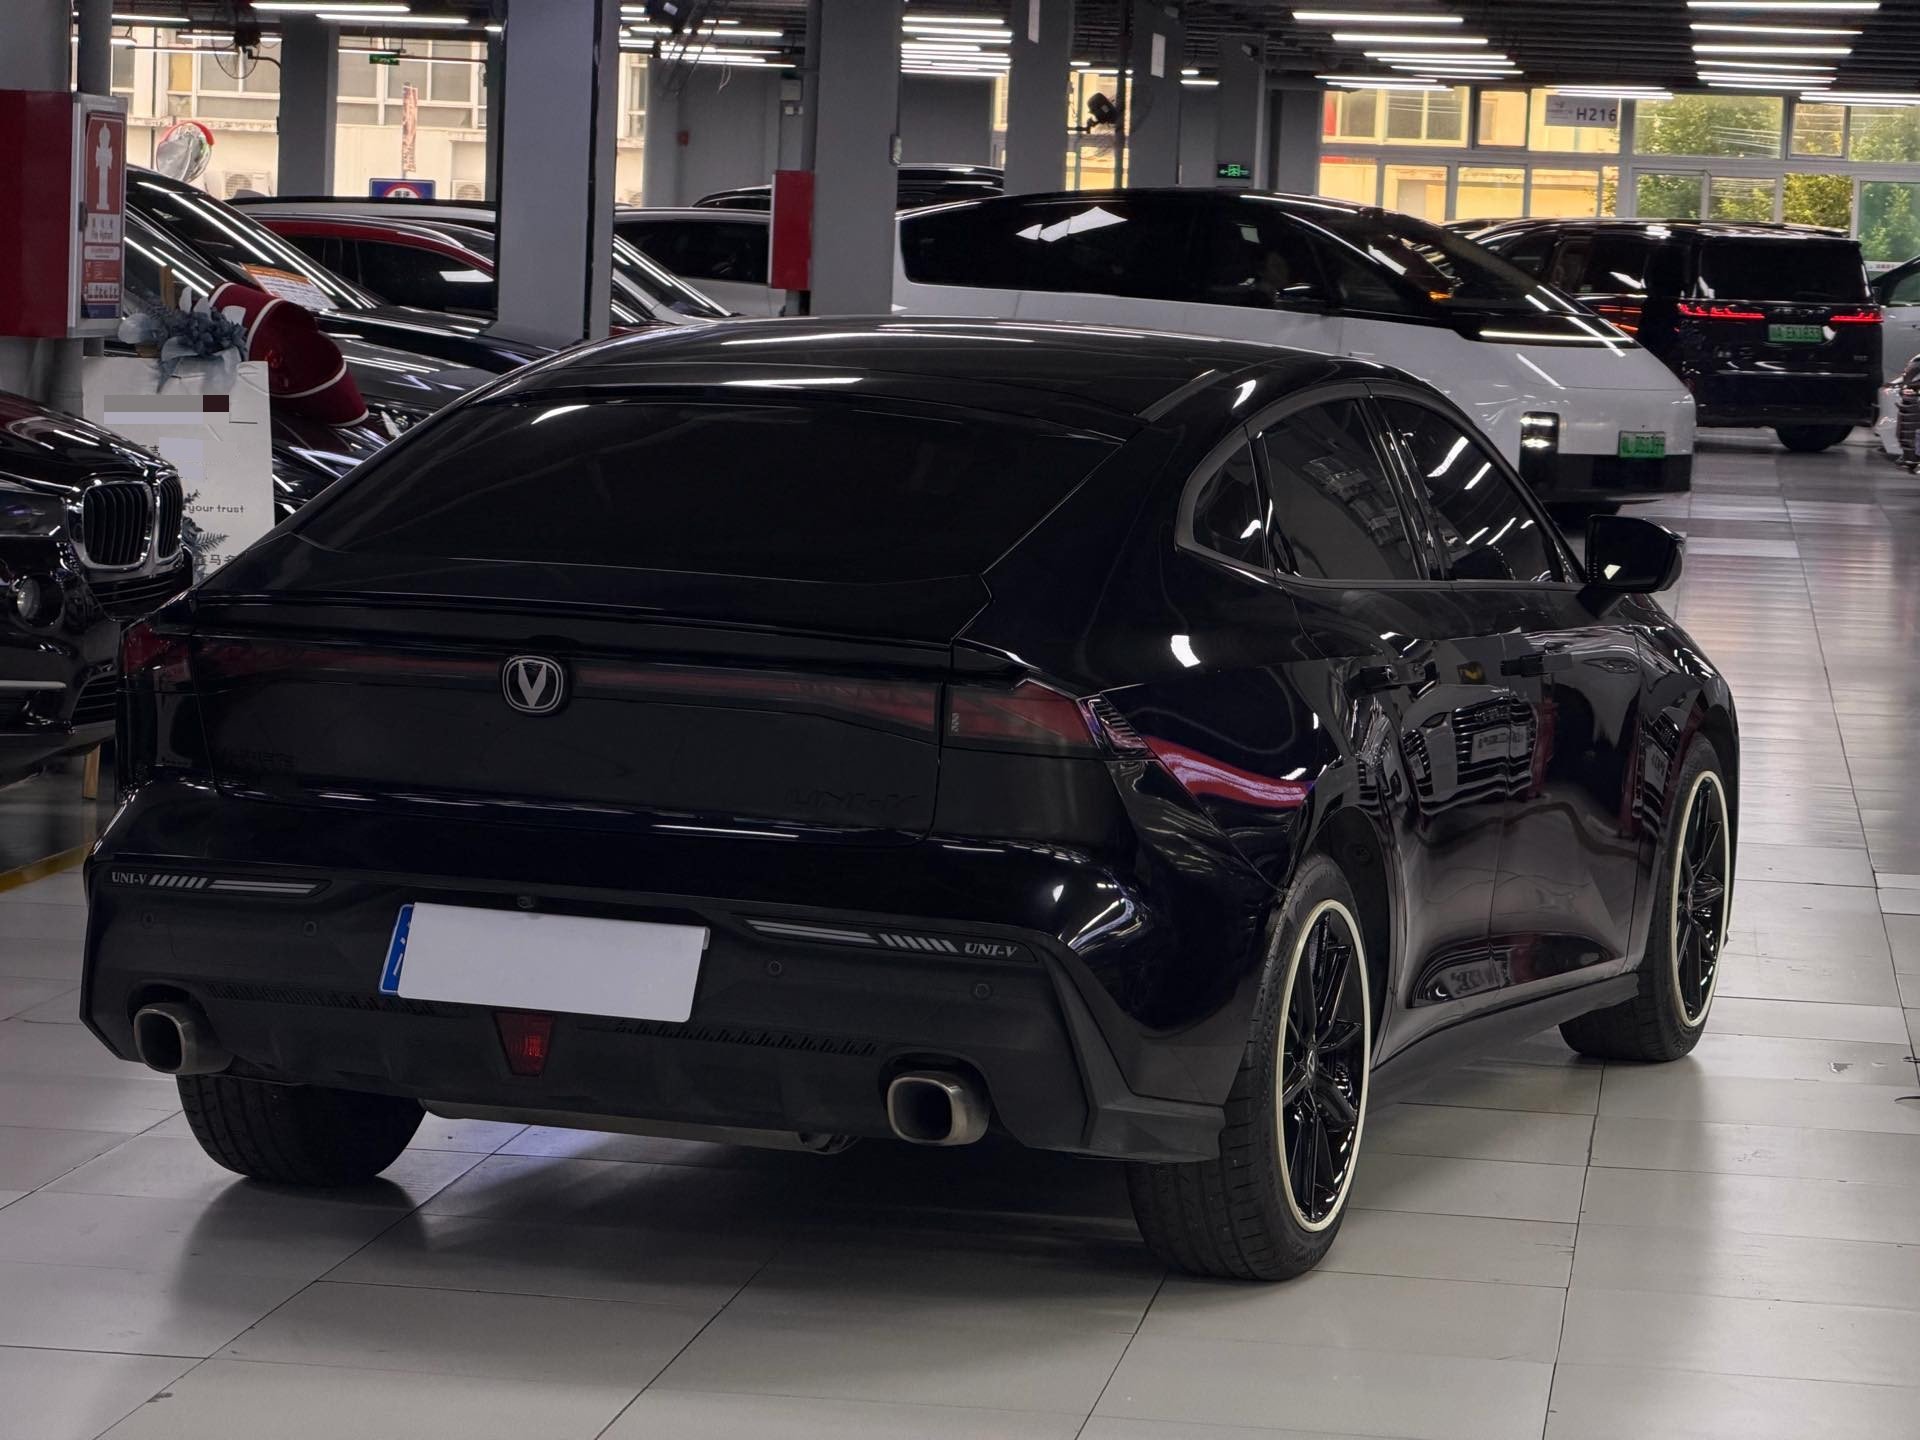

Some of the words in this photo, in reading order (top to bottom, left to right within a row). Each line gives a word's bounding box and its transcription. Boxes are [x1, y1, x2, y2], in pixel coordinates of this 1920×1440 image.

[1576, 107, 1617, 122] H216
[189, 505, 214, 514] your
[217, 504, 244, 513] trust
[111, 871, 148, 885] UNI-V
[964, 943, 1018, 958] UNI-V
